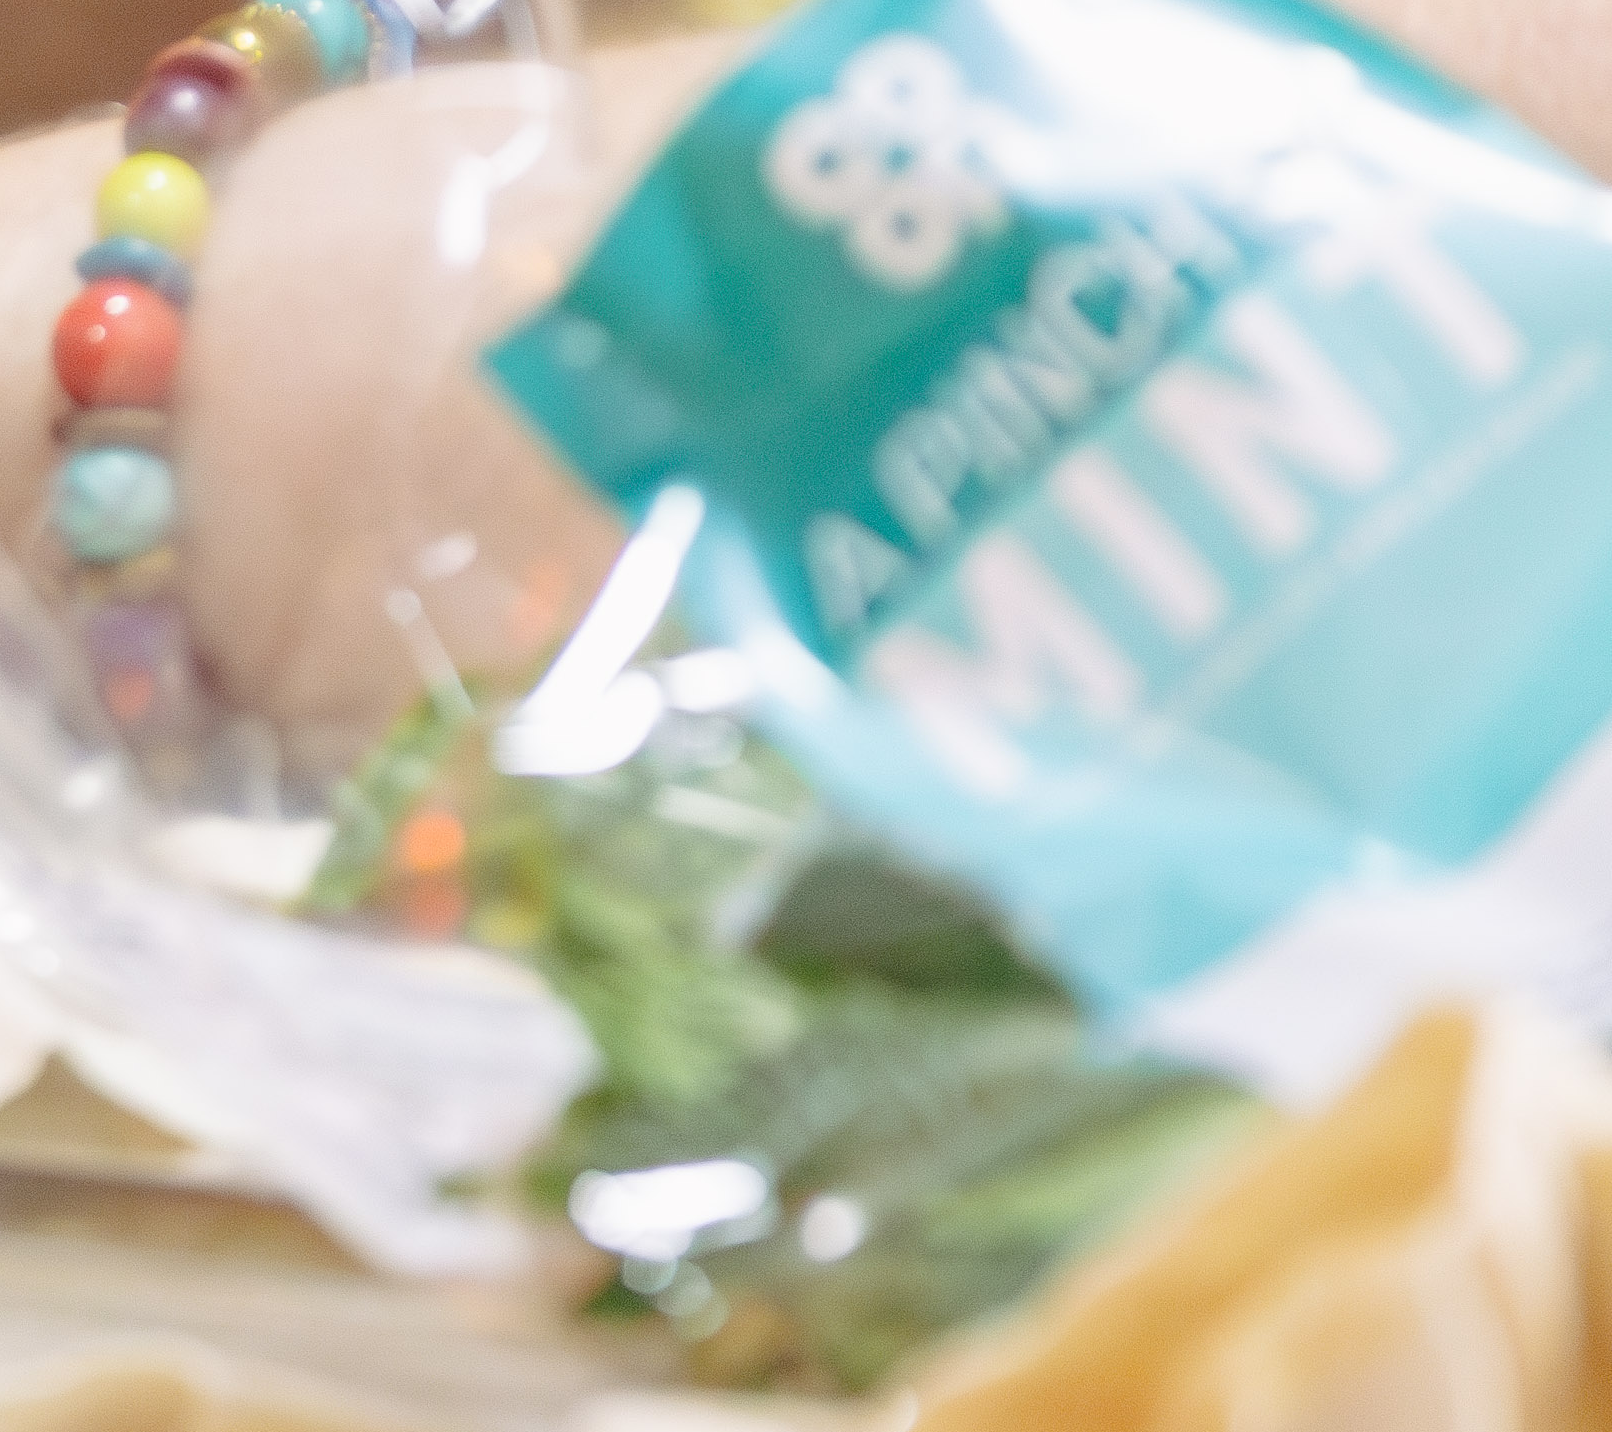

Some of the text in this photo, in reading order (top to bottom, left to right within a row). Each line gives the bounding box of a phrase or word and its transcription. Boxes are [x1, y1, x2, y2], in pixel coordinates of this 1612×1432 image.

[802, 507, 908, 635] A
[872, 187, 1245, 551] PINCH
[865, 171, 1527, 803] MINT
